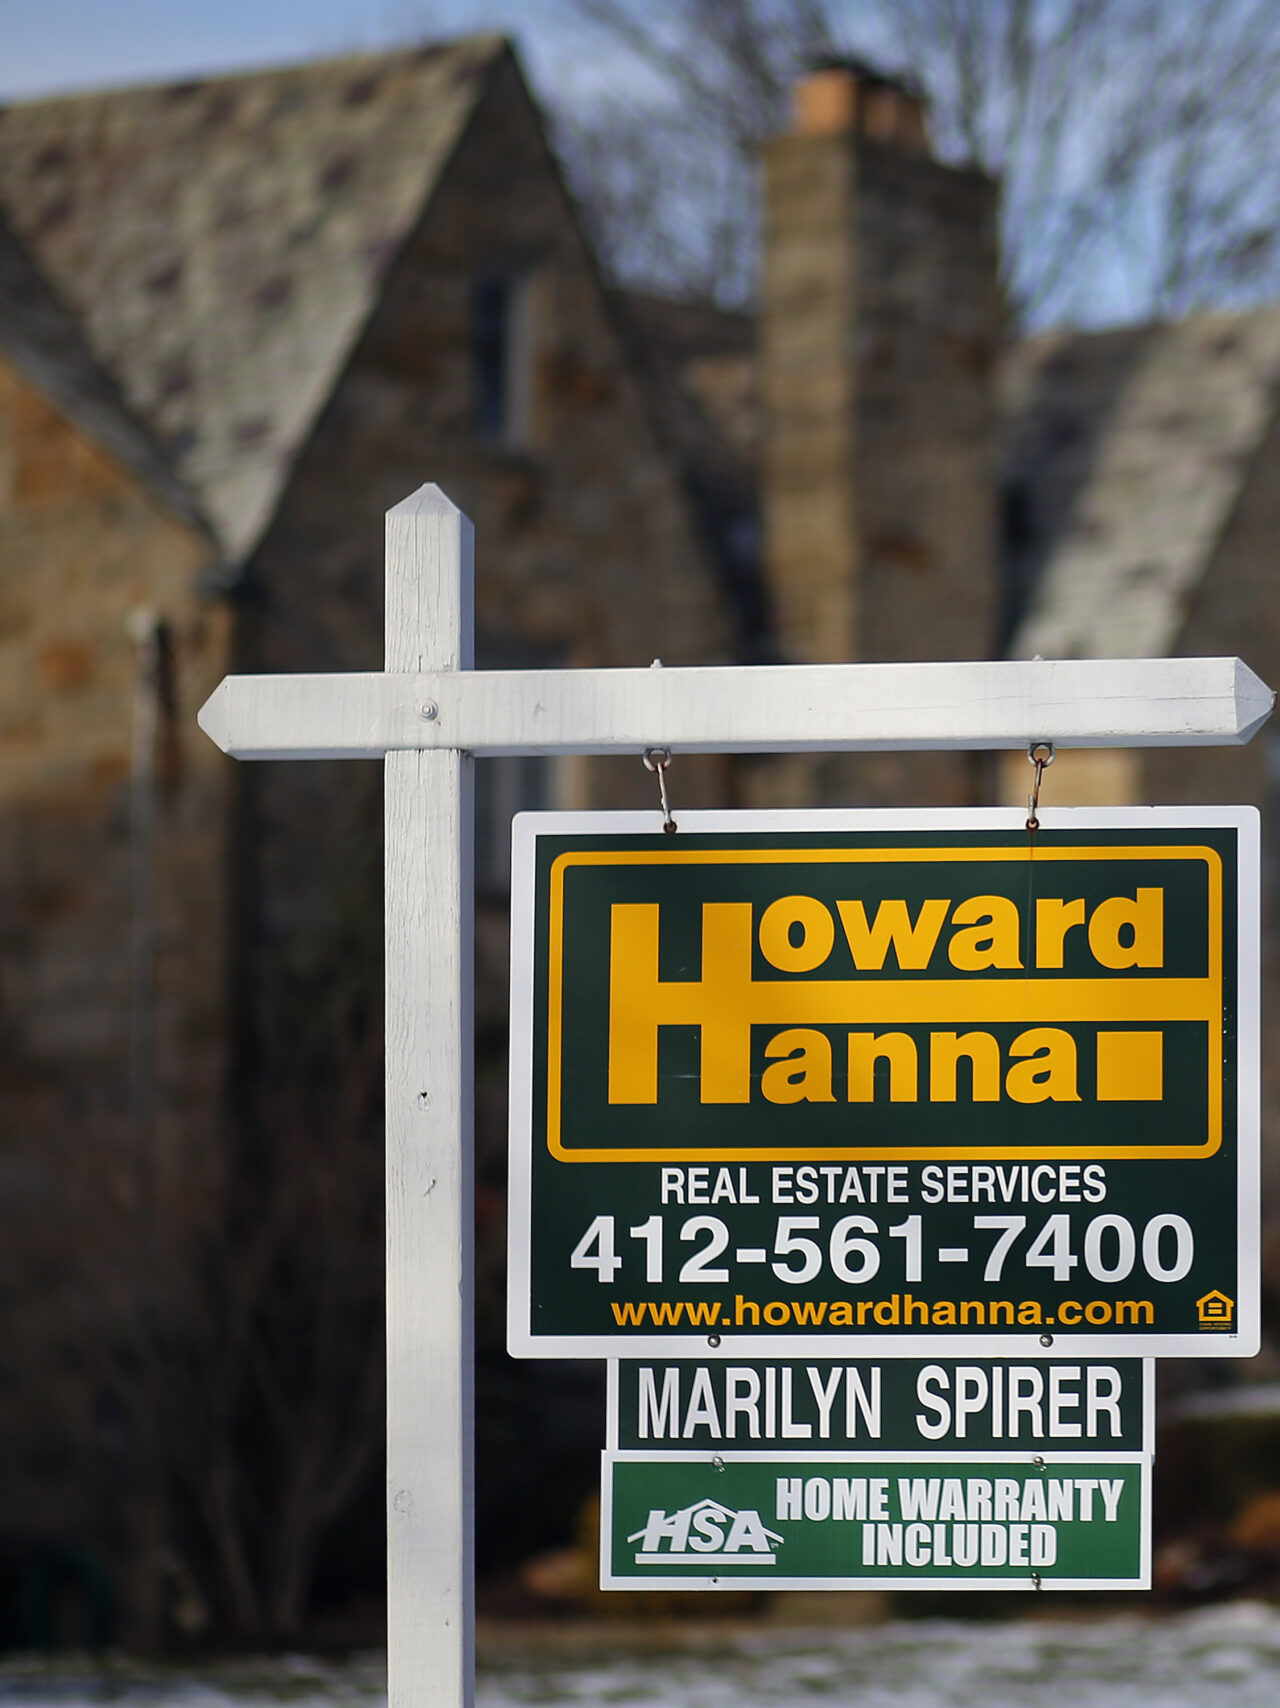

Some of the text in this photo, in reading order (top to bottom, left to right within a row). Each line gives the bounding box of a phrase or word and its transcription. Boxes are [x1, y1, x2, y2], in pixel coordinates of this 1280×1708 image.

[661, 1165, 1107, 1206] REAL ESTATE SERVICES
[570, 1214, 1194, 1284] 412-561-7400
[610, 1294, 1155, 1326] www.howardhanna.com
[638, 1364, 1124, 1440] MARILYN SPIRER
[775, 1477, 1125, 1522] HOME WARRANTY
[641, 1509, 772, 1553] HSA
[862, 1522, 1057, 1567] INCLUDED
